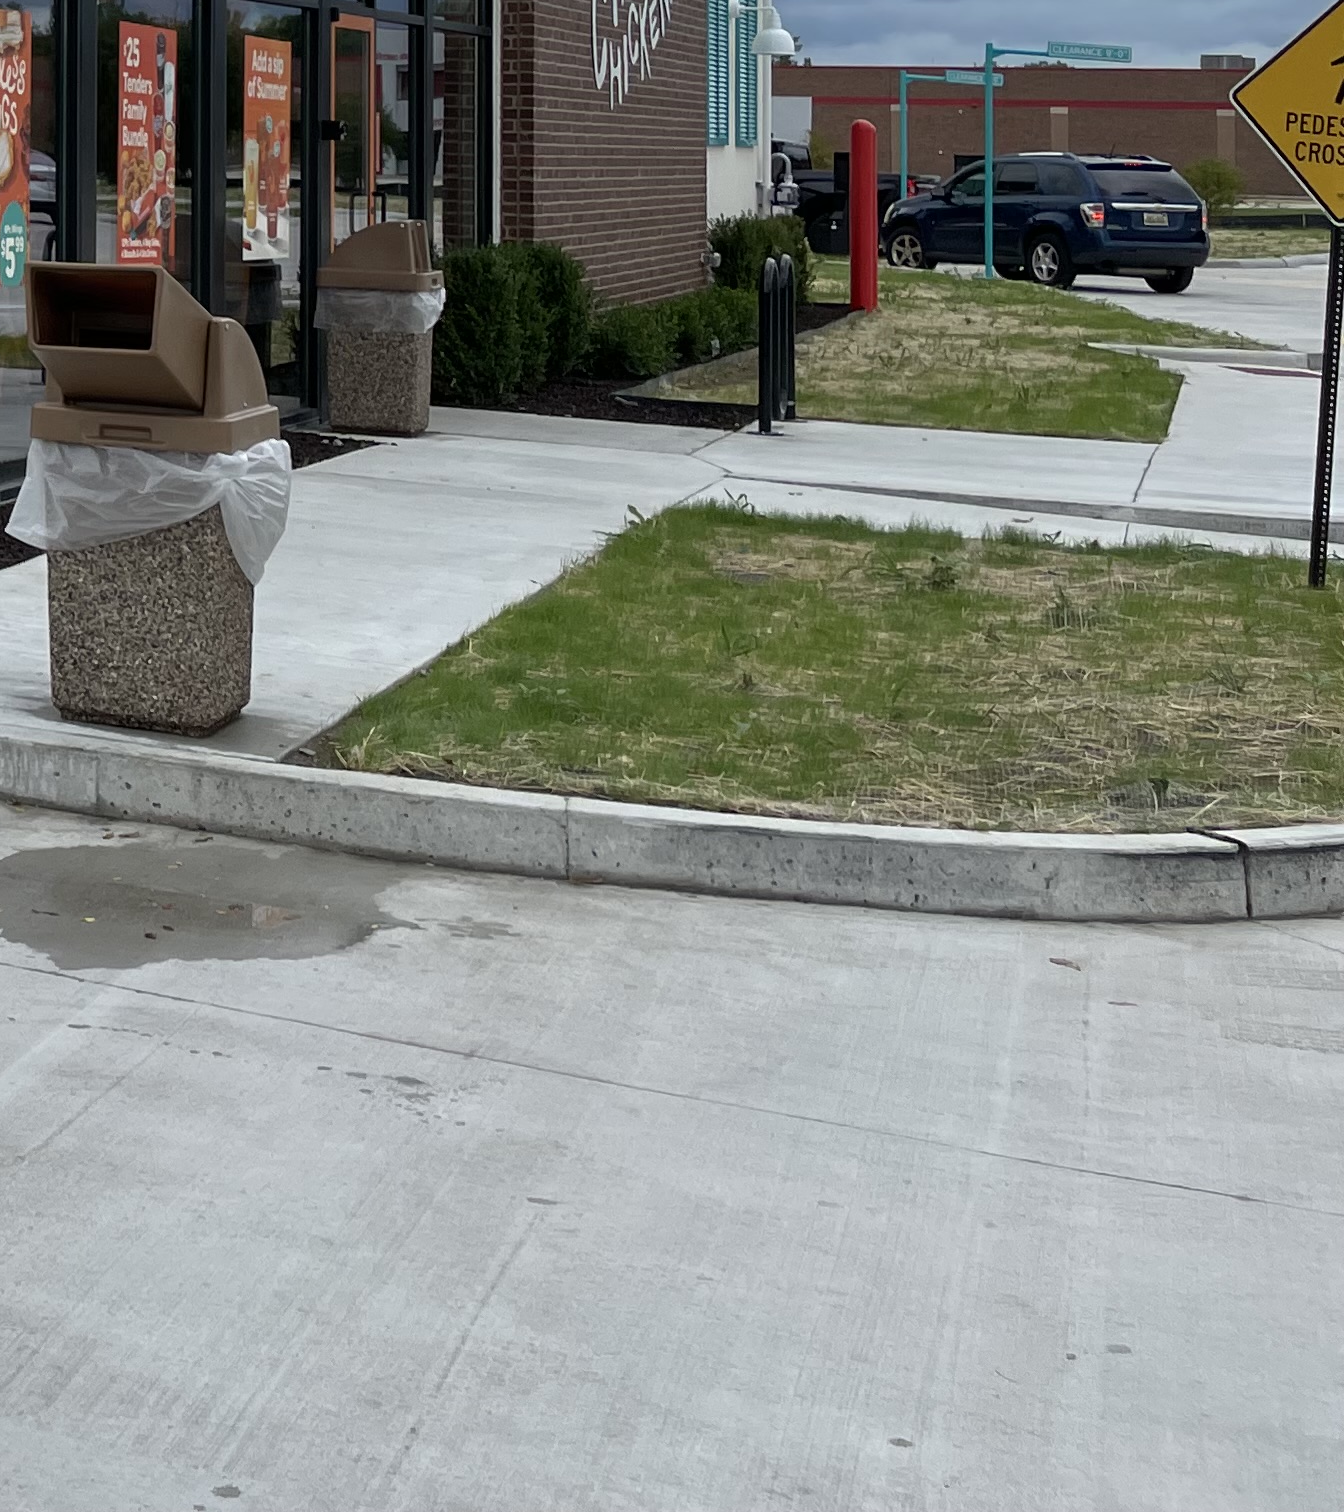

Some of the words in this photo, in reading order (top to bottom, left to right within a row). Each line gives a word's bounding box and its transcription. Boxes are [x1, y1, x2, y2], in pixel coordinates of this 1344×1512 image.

[1053, 45, 1103, 57] CLEARANCE
[251, 49, 267, 72] Add
[267, 56, 272, 73] a
[273, 52, 284, 79] sip
[123, 71, 153, 95] Tenders
[247, 75, 257, 98] of
[257, 75, 288, 101] Summer
[122, 98, 147, 125] Family
[122, 125, 149, 147] Bundle
